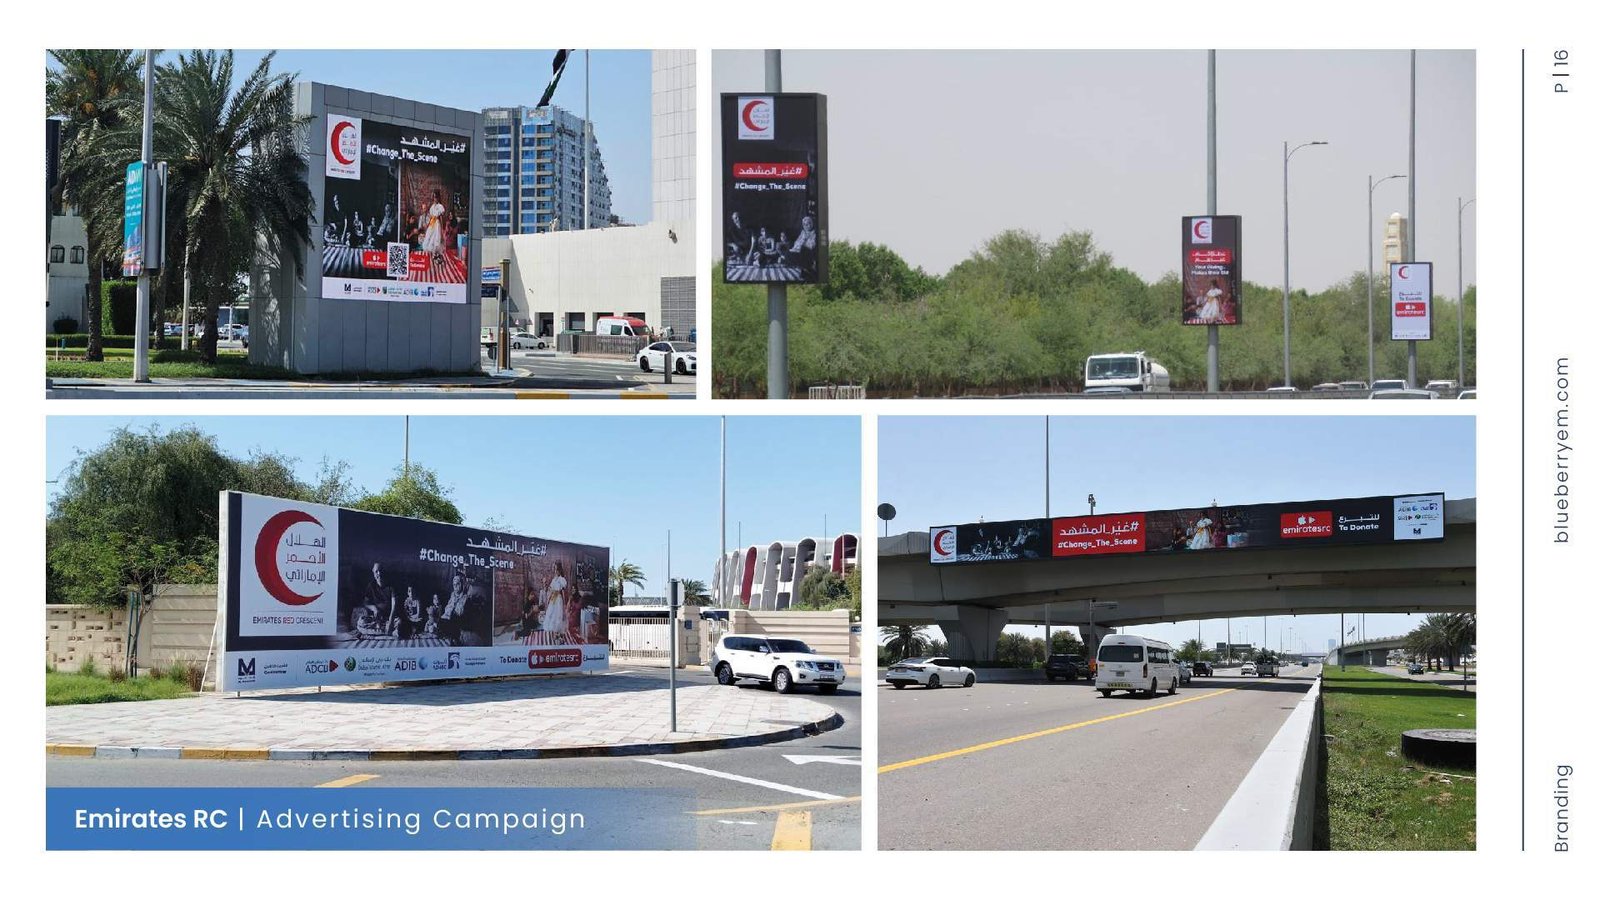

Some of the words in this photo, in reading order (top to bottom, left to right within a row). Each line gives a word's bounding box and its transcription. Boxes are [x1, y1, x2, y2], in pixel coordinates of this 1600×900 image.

[366, 144, 438, 163] #Change_The_Scene
[735, 182, 806, 191] #Change_The_Scene
[1350, 523, 1379, 531] Donate
[1057, 538, 1138, 549] #Change_The_Scene
[419, 547, 514, 569] #Change_The_Scene
[252, 617, 281, 625] EMIRATES
[283, 617, 294, 625] RED
[395, 661, 417, 671] ADIB
